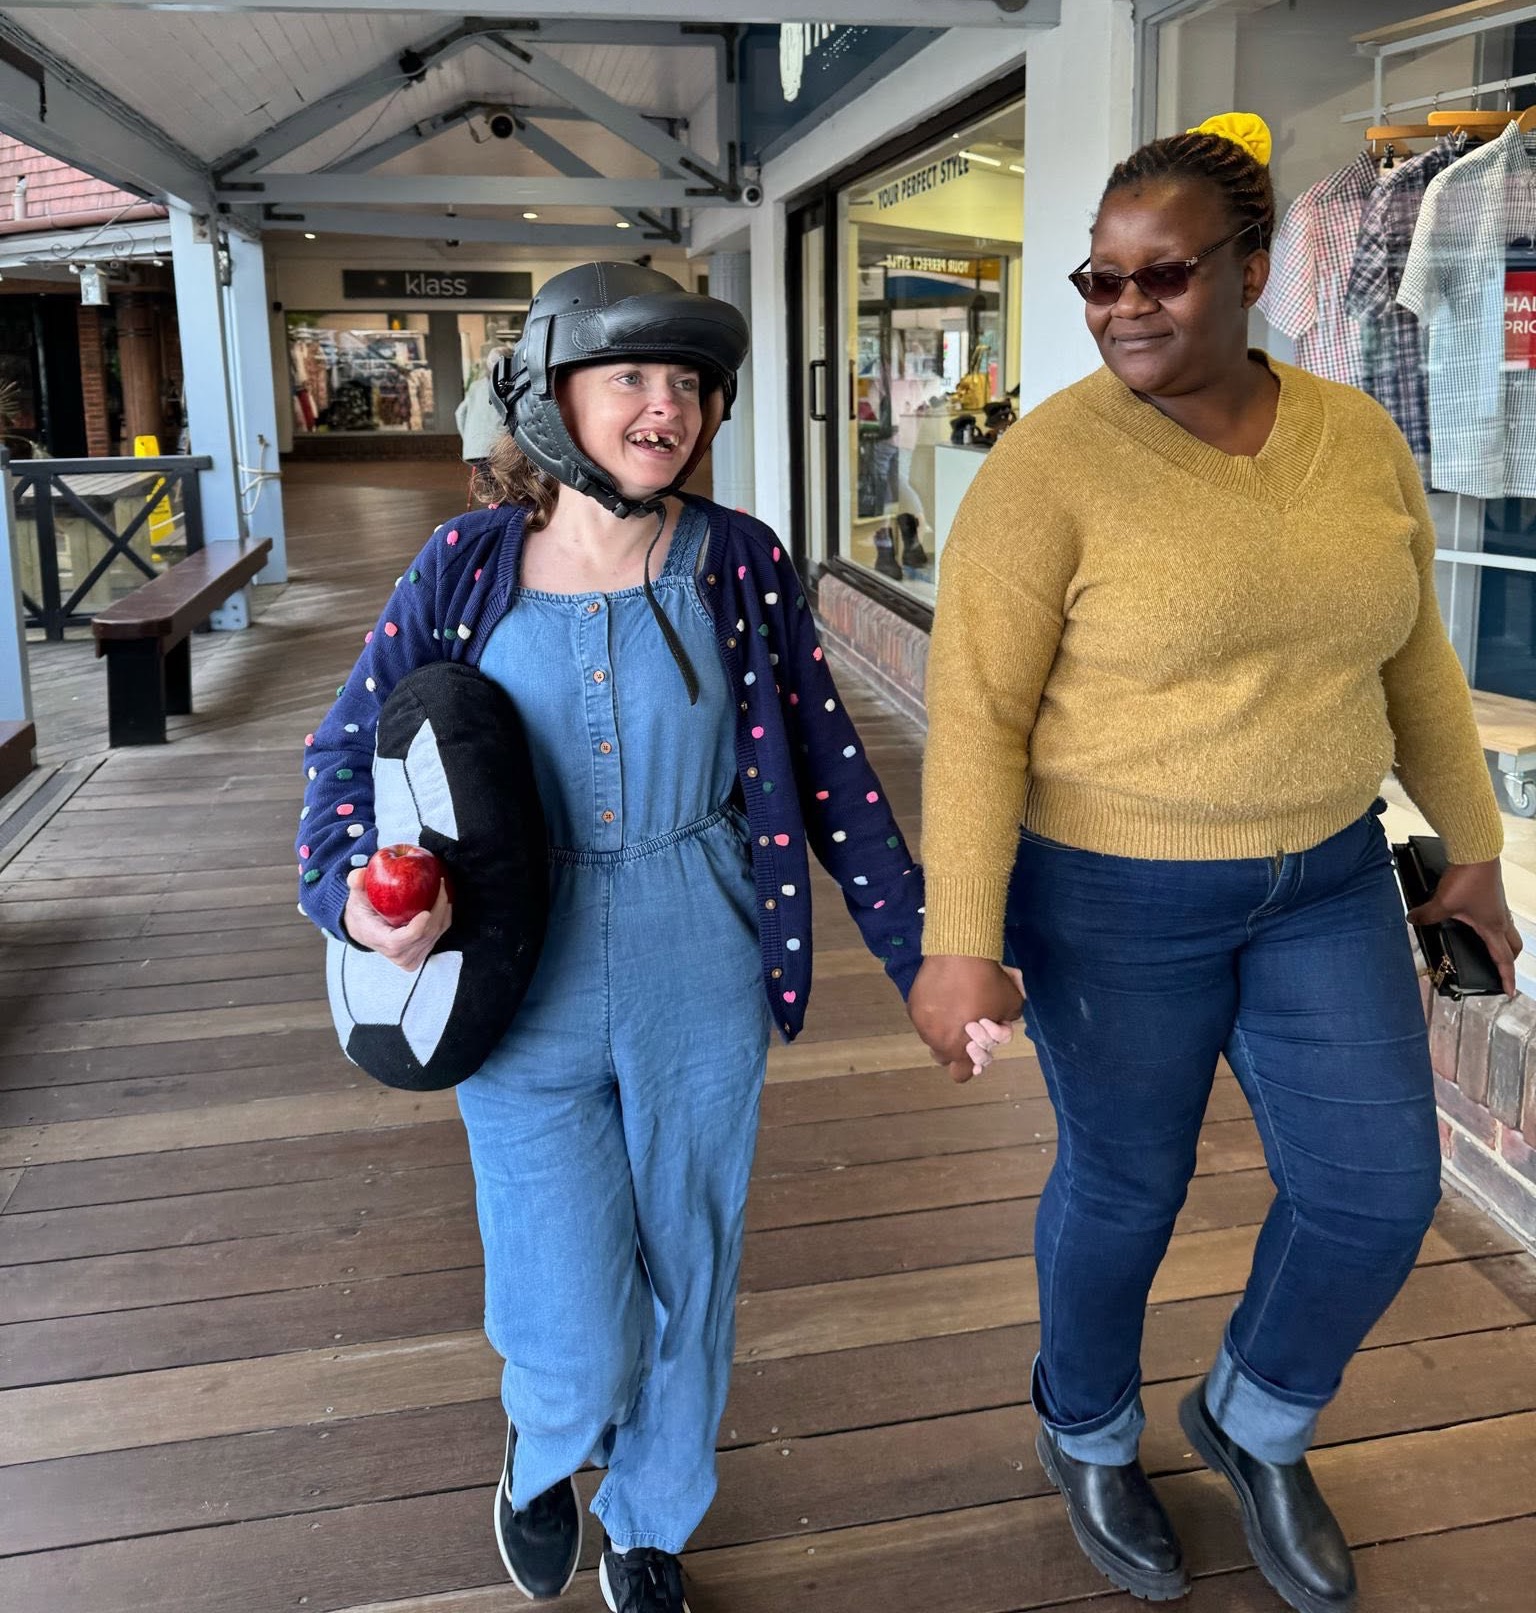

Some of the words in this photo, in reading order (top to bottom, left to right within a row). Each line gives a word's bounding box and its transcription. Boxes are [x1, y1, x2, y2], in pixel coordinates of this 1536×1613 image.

[877, 183, 899, 210] YOUR
[901, 165, 937, 201] PERFECT
[940, 152, 969, 184] STYLE
[405, 273, 468, 296] klass
